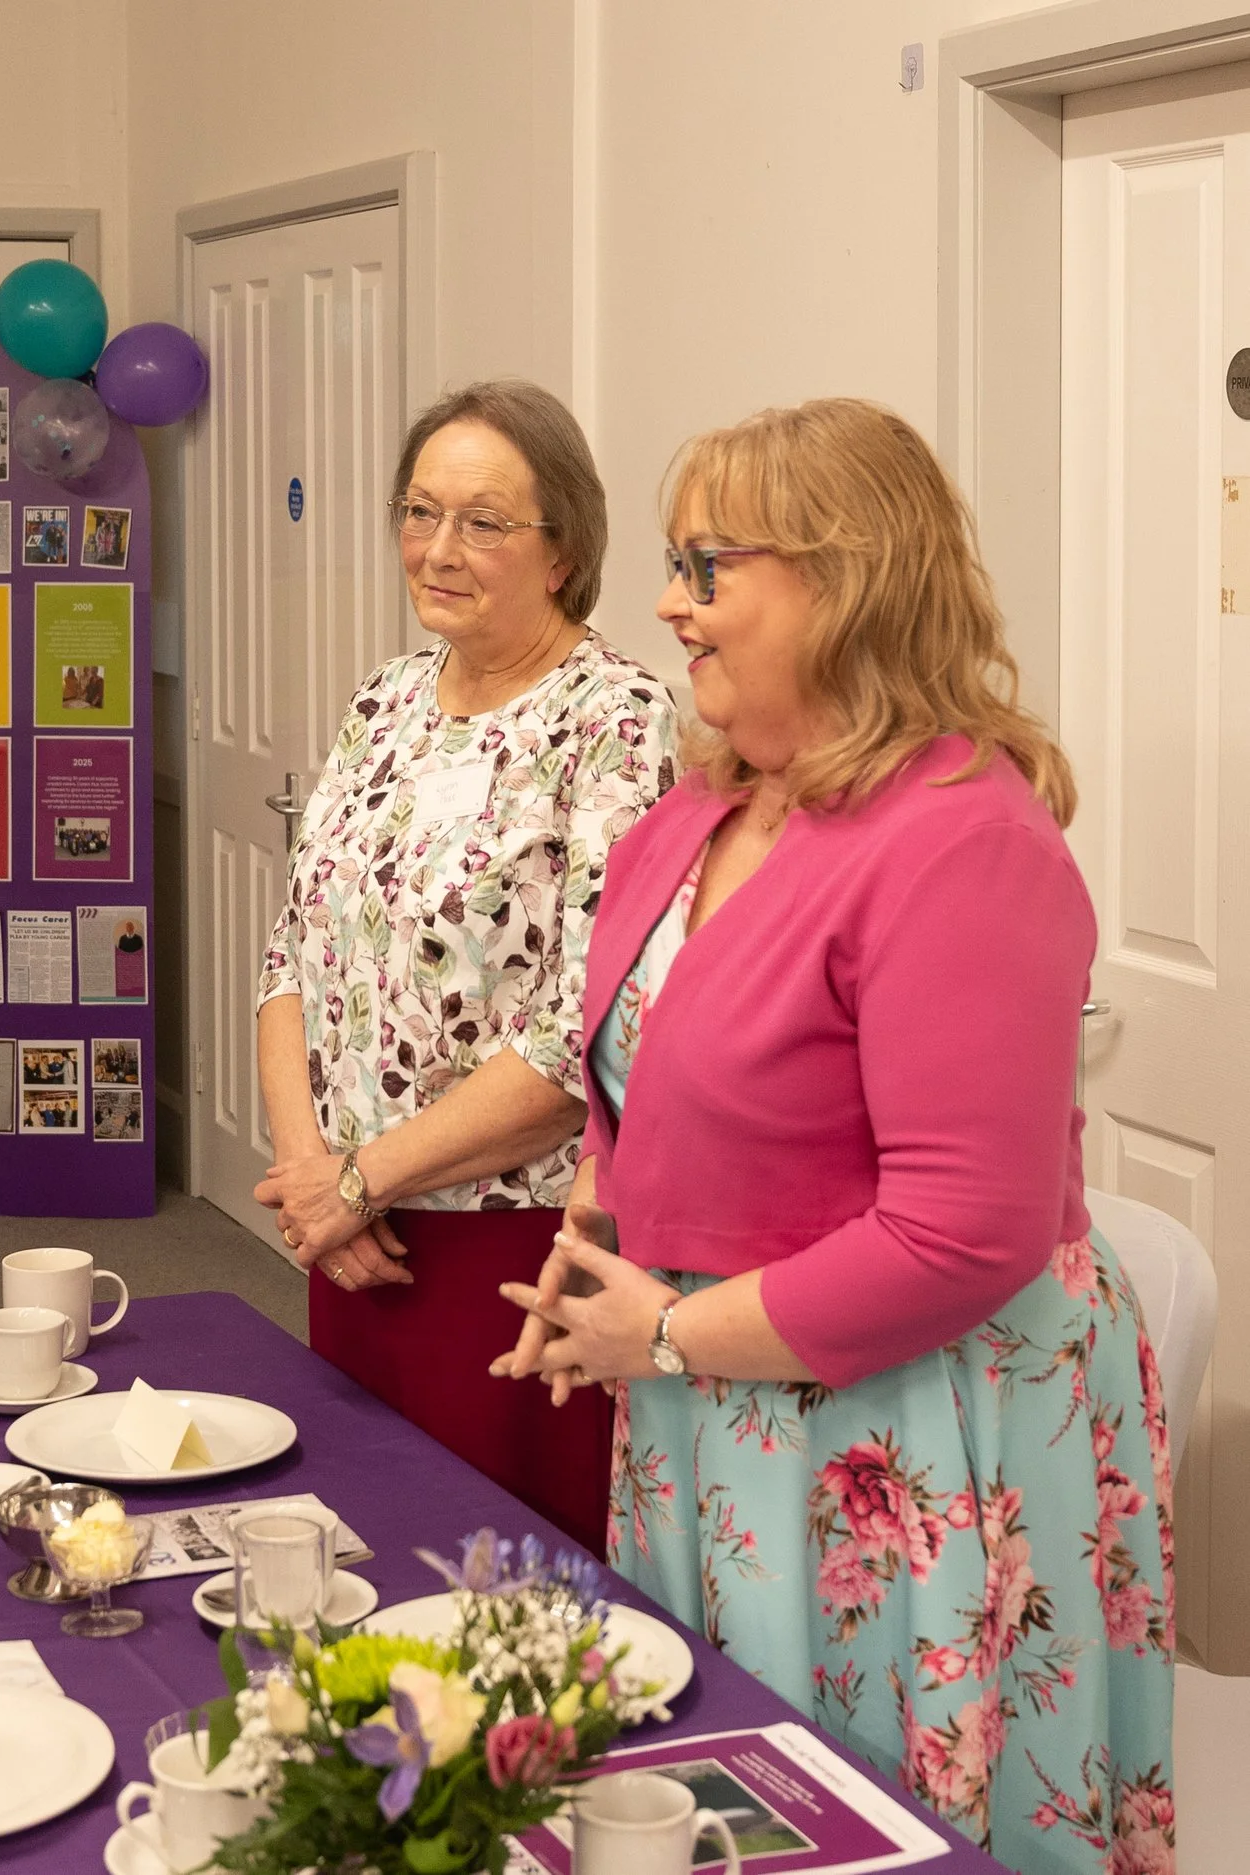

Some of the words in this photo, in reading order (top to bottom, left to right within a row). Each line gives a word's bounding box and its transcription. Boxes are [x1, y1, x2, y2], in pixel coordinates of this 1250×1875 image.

[72, 758, 93, 767] 2025
[11, 915, 38, 923] Focus
[42, 915, 69, 923] Carer
